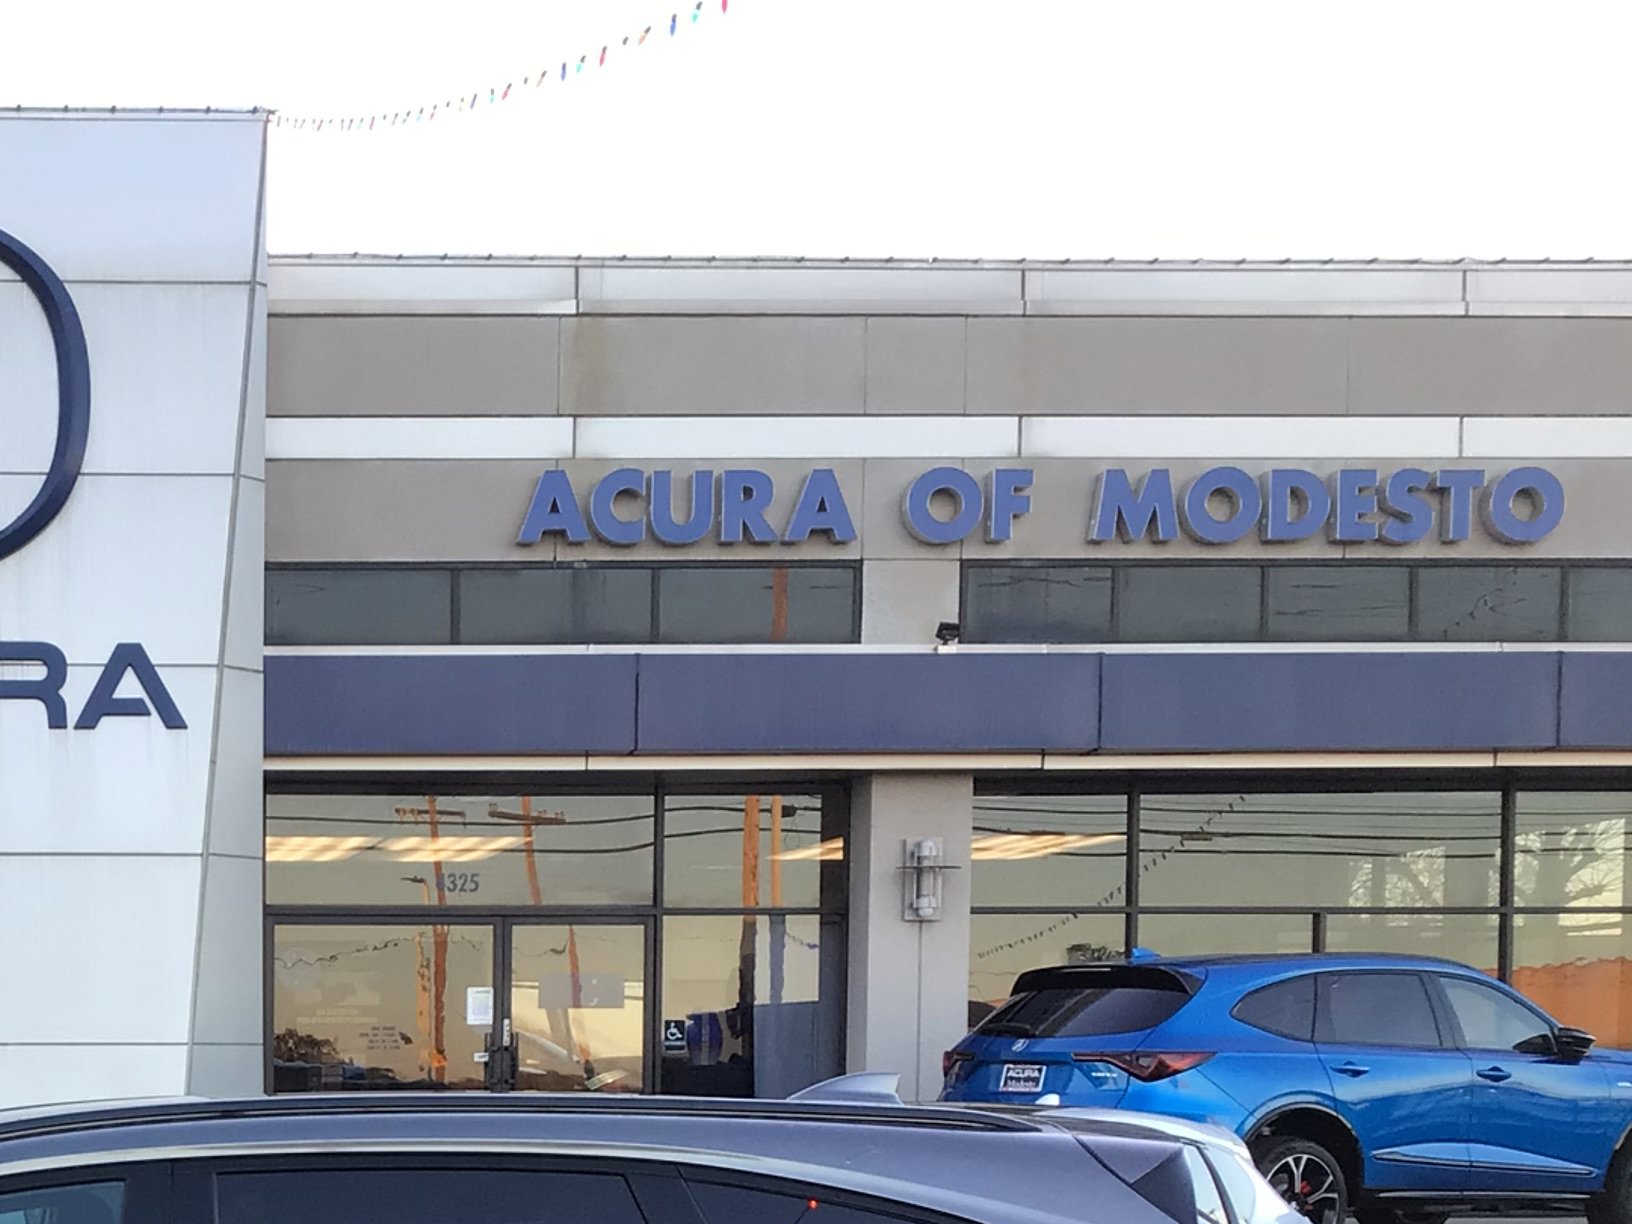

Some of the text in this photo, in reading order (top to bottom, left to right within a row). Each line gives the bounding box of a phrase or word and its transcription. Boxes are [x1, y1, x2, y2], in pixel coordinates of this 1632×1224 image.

[516, 466, 1566, 546] ACURA OF MODESTO
[1007, 1069, 1040, 1078] ACURA
